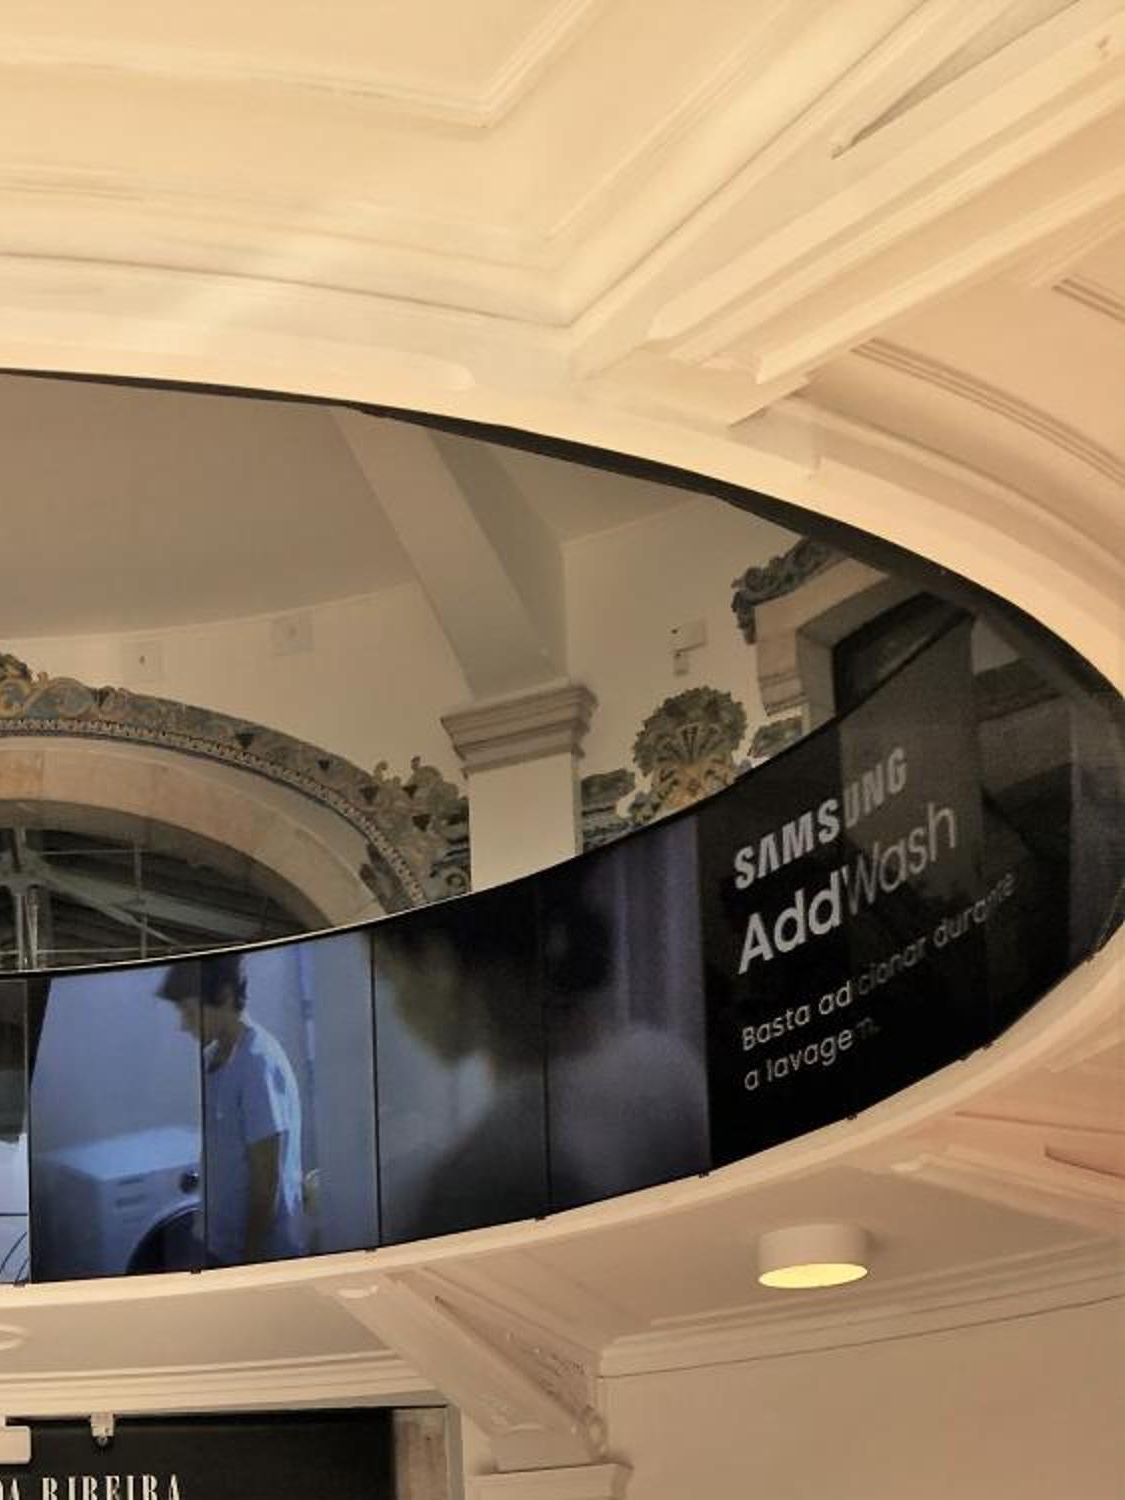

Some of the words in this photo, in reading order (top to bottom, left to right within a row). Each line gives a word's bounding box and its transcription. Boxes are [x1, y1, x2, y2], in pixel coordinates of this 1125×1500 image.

[733, 746, 908, 890] SAMSUNG
[738, 802, 957, 975] AddWash
[742, 1002, 811, 1052] Basta
[743, 1069, 760, 1092] a
